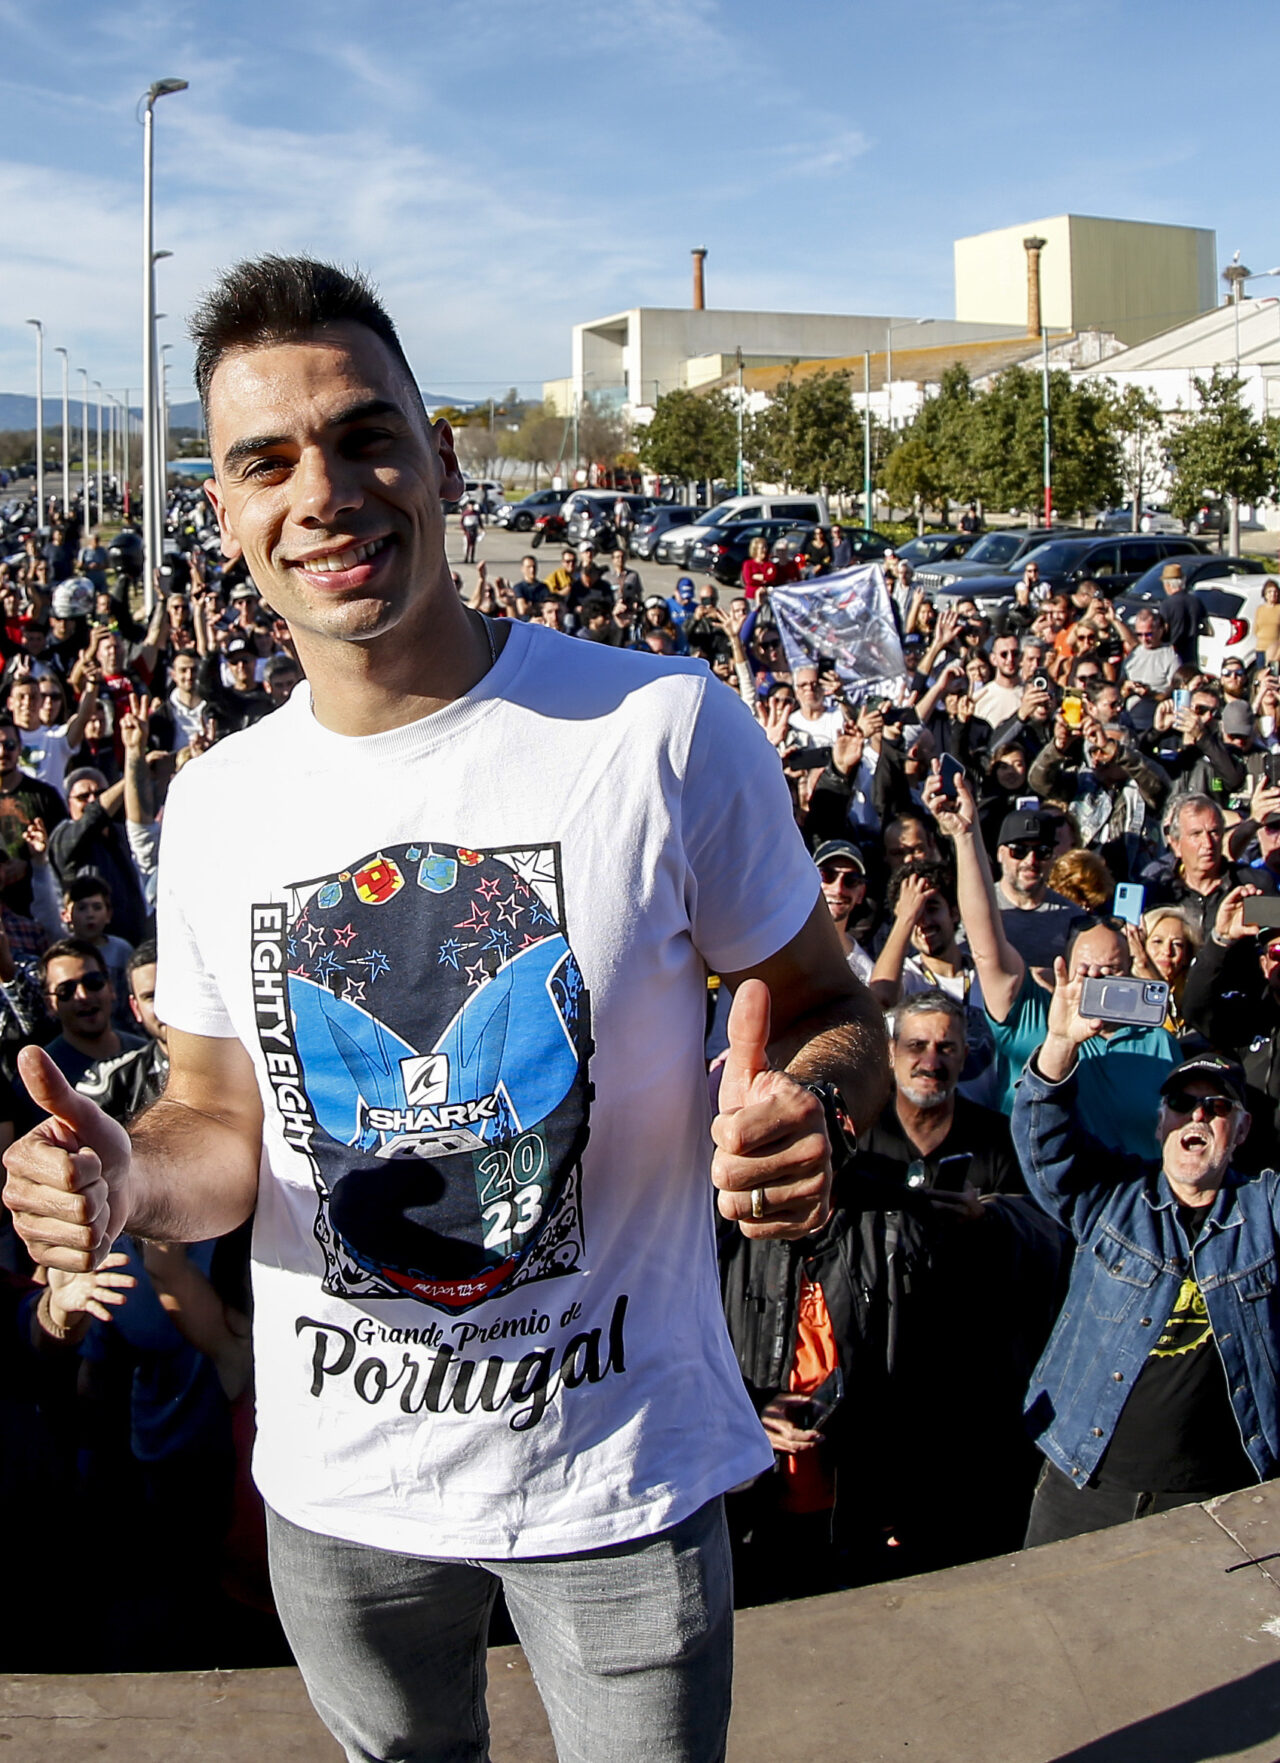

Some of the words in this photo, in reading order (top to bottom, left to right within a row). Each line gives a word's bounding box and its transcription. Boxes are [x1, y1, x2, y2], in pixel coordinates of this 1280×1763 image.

[253, 908, 291, 1048] EIGHTY
[265, 1052, 313, 1156] EIGHT
[368, 1095, 496, 1132] SHARK
[478, 1133, 544, 1205] 20
[481, 1185, 543, 1249] 23
[353, 1317, 444, 1348] Grande
[451, 1308, 551, 1350] Prémio
[560, 1302, 582, 1328] de
[295, 1294, 629, 1431] Portugal
